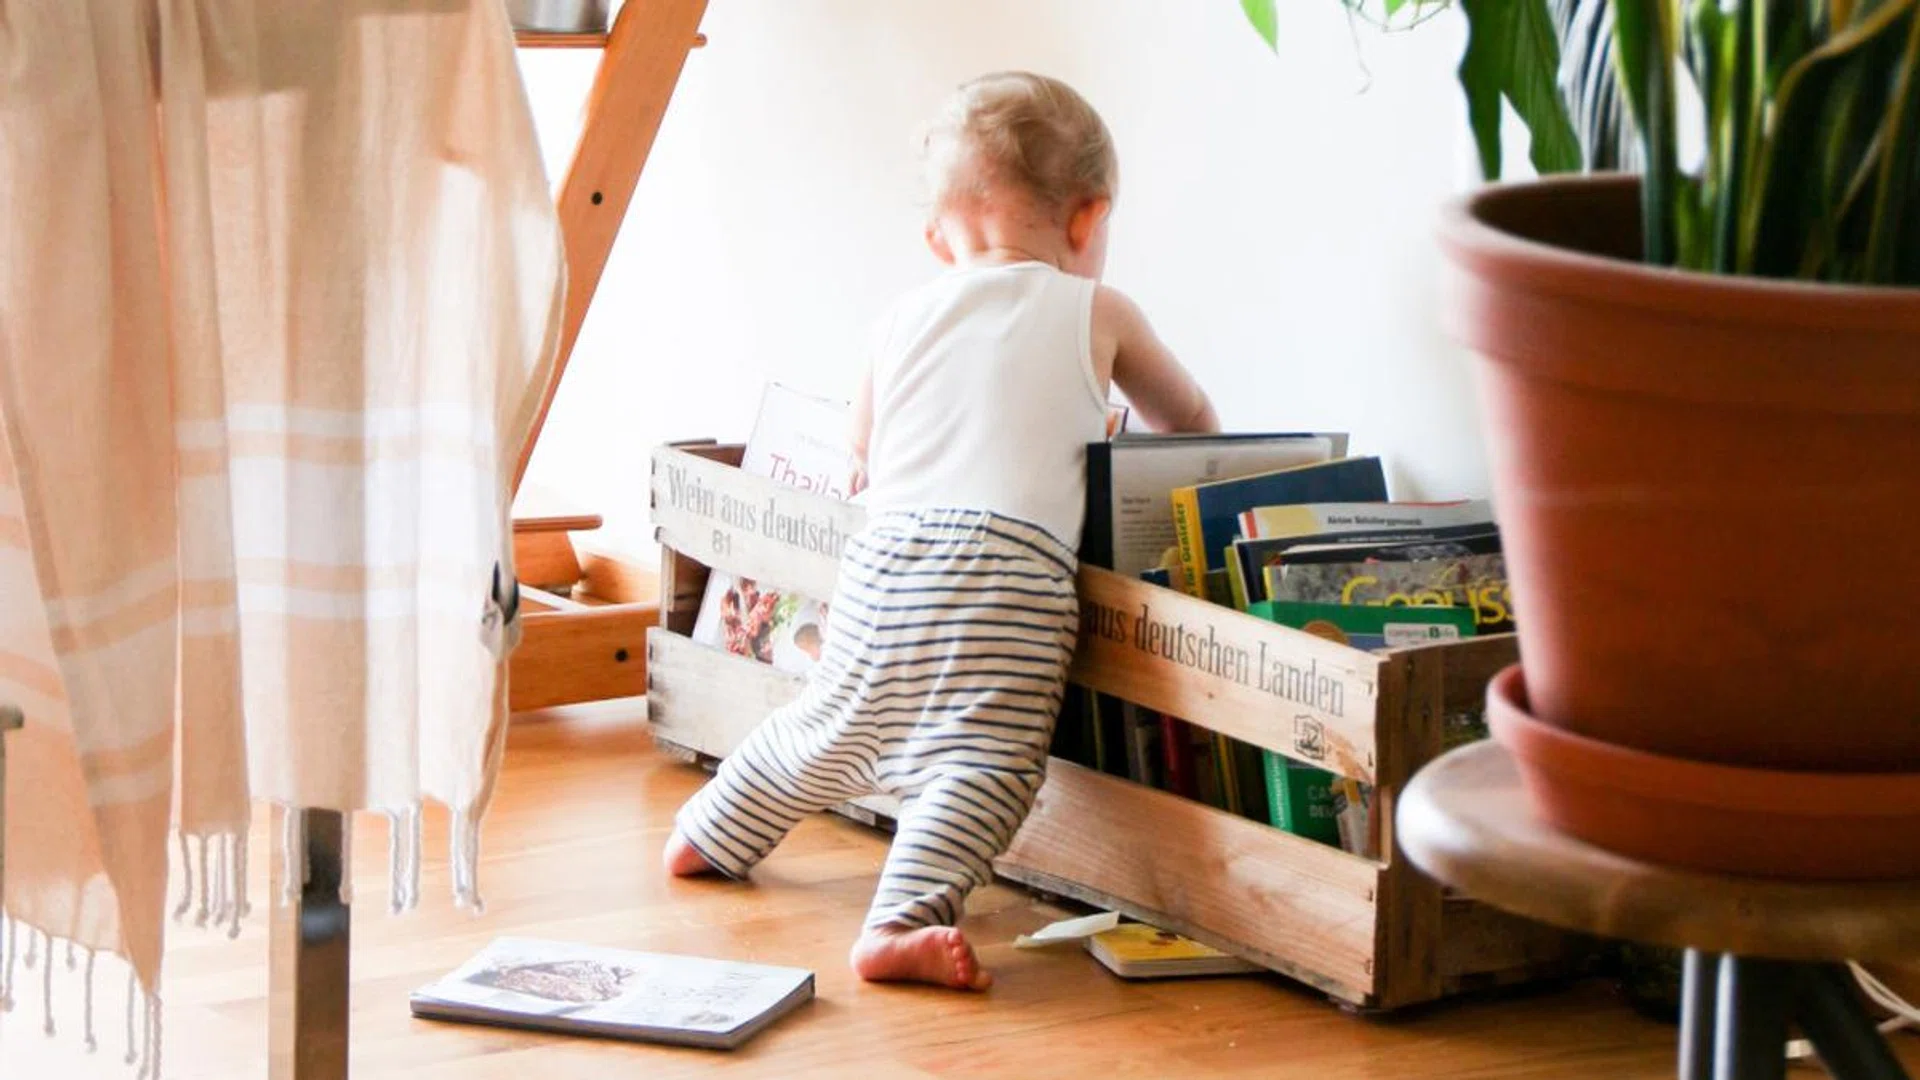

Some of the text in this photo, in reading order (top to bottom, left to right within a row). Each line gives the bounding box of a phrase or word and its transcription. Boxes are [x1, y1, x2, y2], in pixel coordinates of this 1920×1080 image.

[667, 464, 850, 560] Wein aus deutsch
[1088, 602, 1344, 717] aus deutschen Landen
